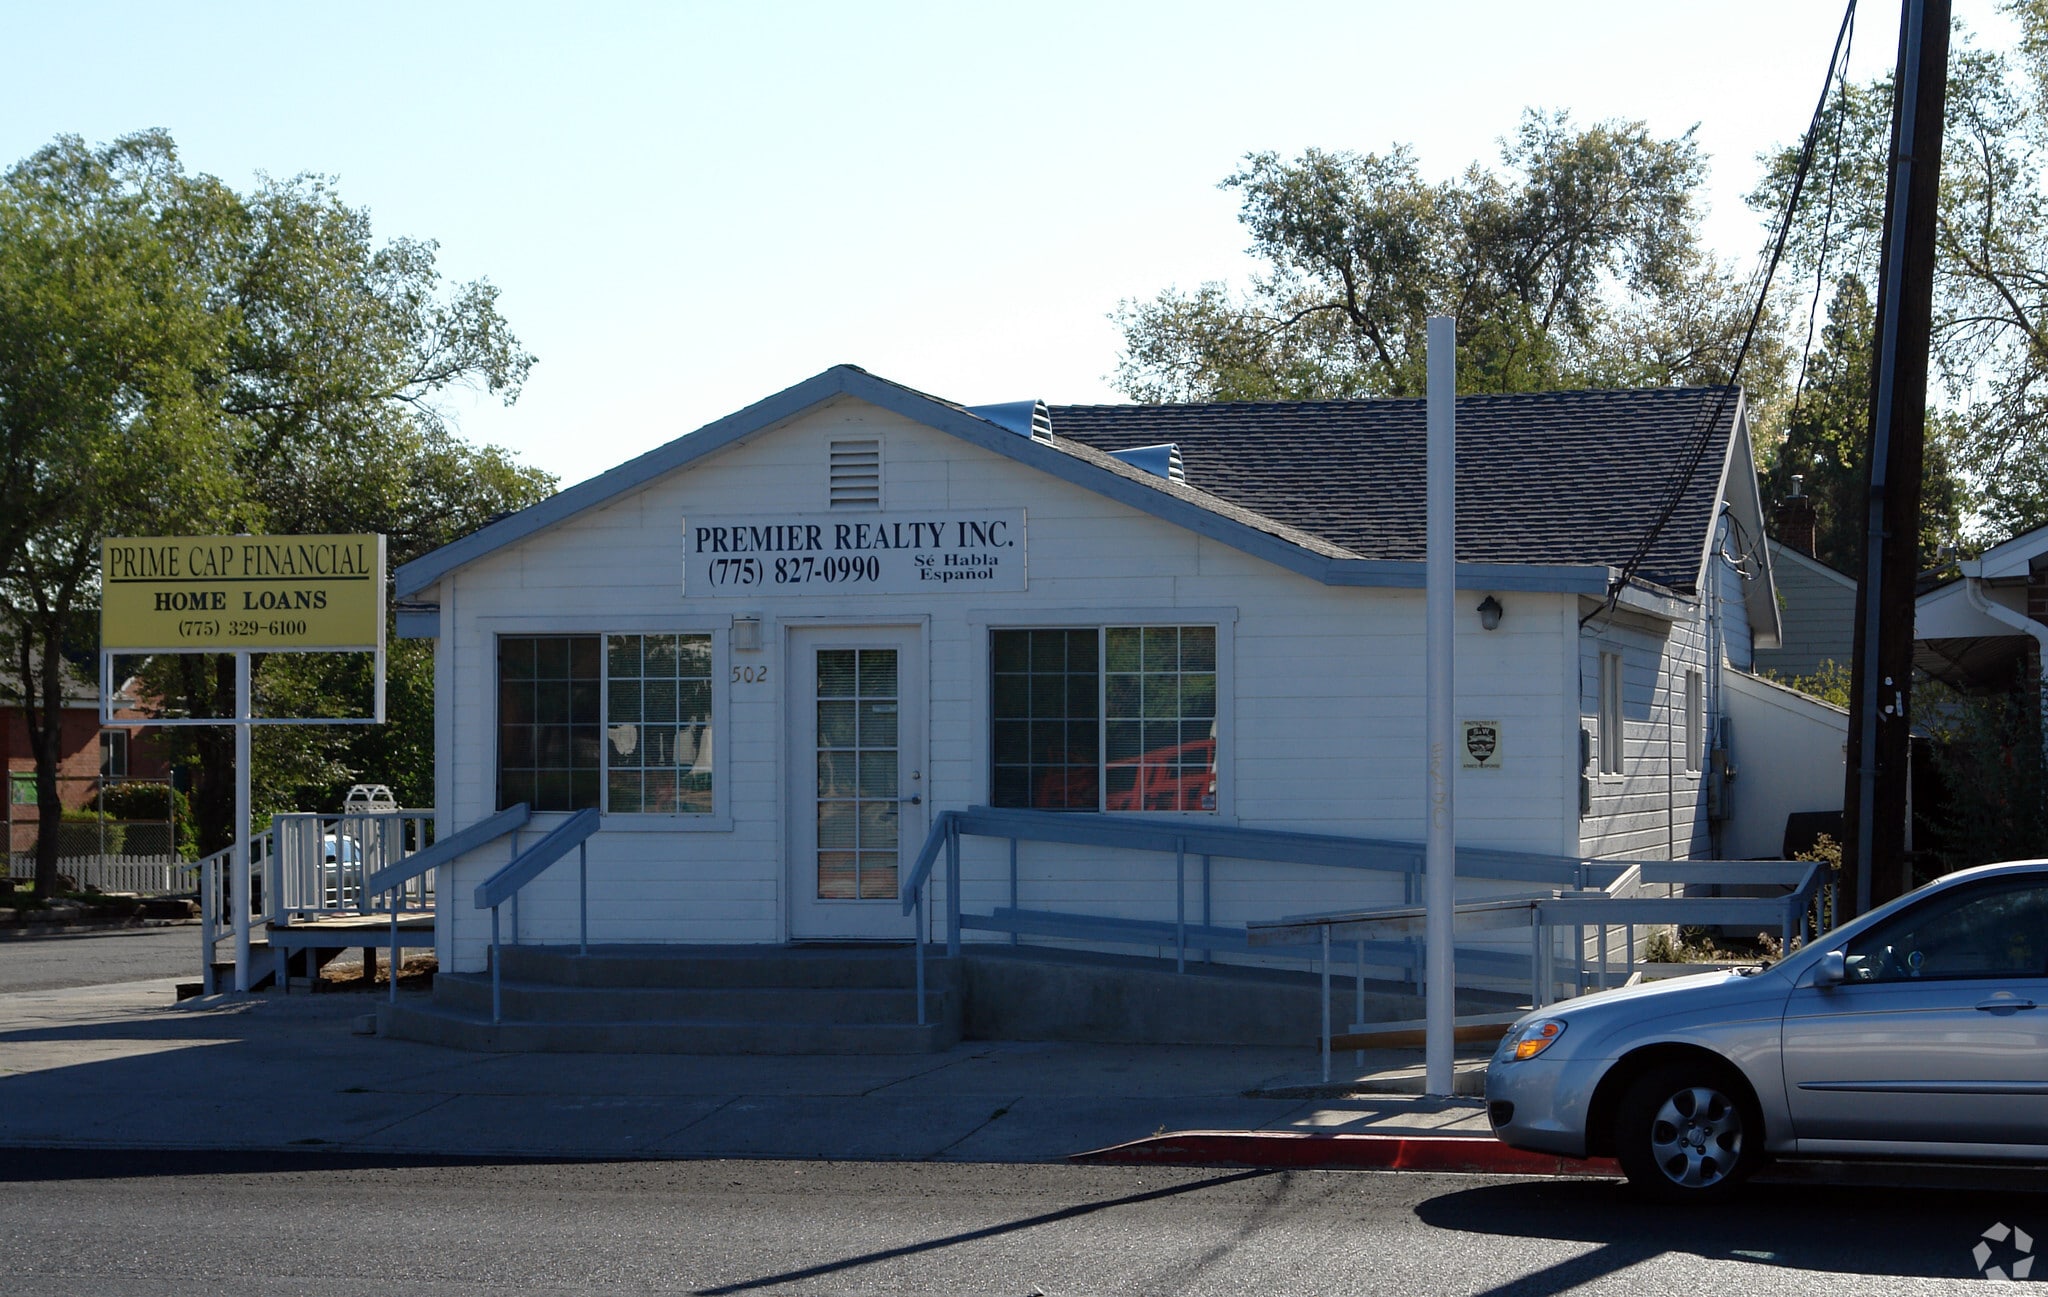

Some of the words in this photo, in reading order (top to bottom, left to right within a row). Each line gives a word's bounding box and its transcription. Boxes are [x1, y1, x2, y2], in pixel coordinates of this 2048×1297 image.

[695, 524, 823, 553] PREMIER
[834, 521, 946, 550] REALTY
[958, 520, 1014, 548] INC.
[110, 546, 180, 577] PRIME
[189, 545, 233, 576] CAP
[243, 544, 370, 575] FINANCIAL
[914, 554, 935, 567] Sé
[943, 553, 999, 567] Habla
[708, 557, 763, 588] (775)
[775, 555, 880, 584] 827-0990
[919, 566, 994, 583] Español
[154, 591, 226, 611] HOME
[243, 590, 327, 610] LOANS
[179, 619, 219, 637] (775)
[229, 619, 307, 636] 329-6100
[730, 665, 768, 684] 502
